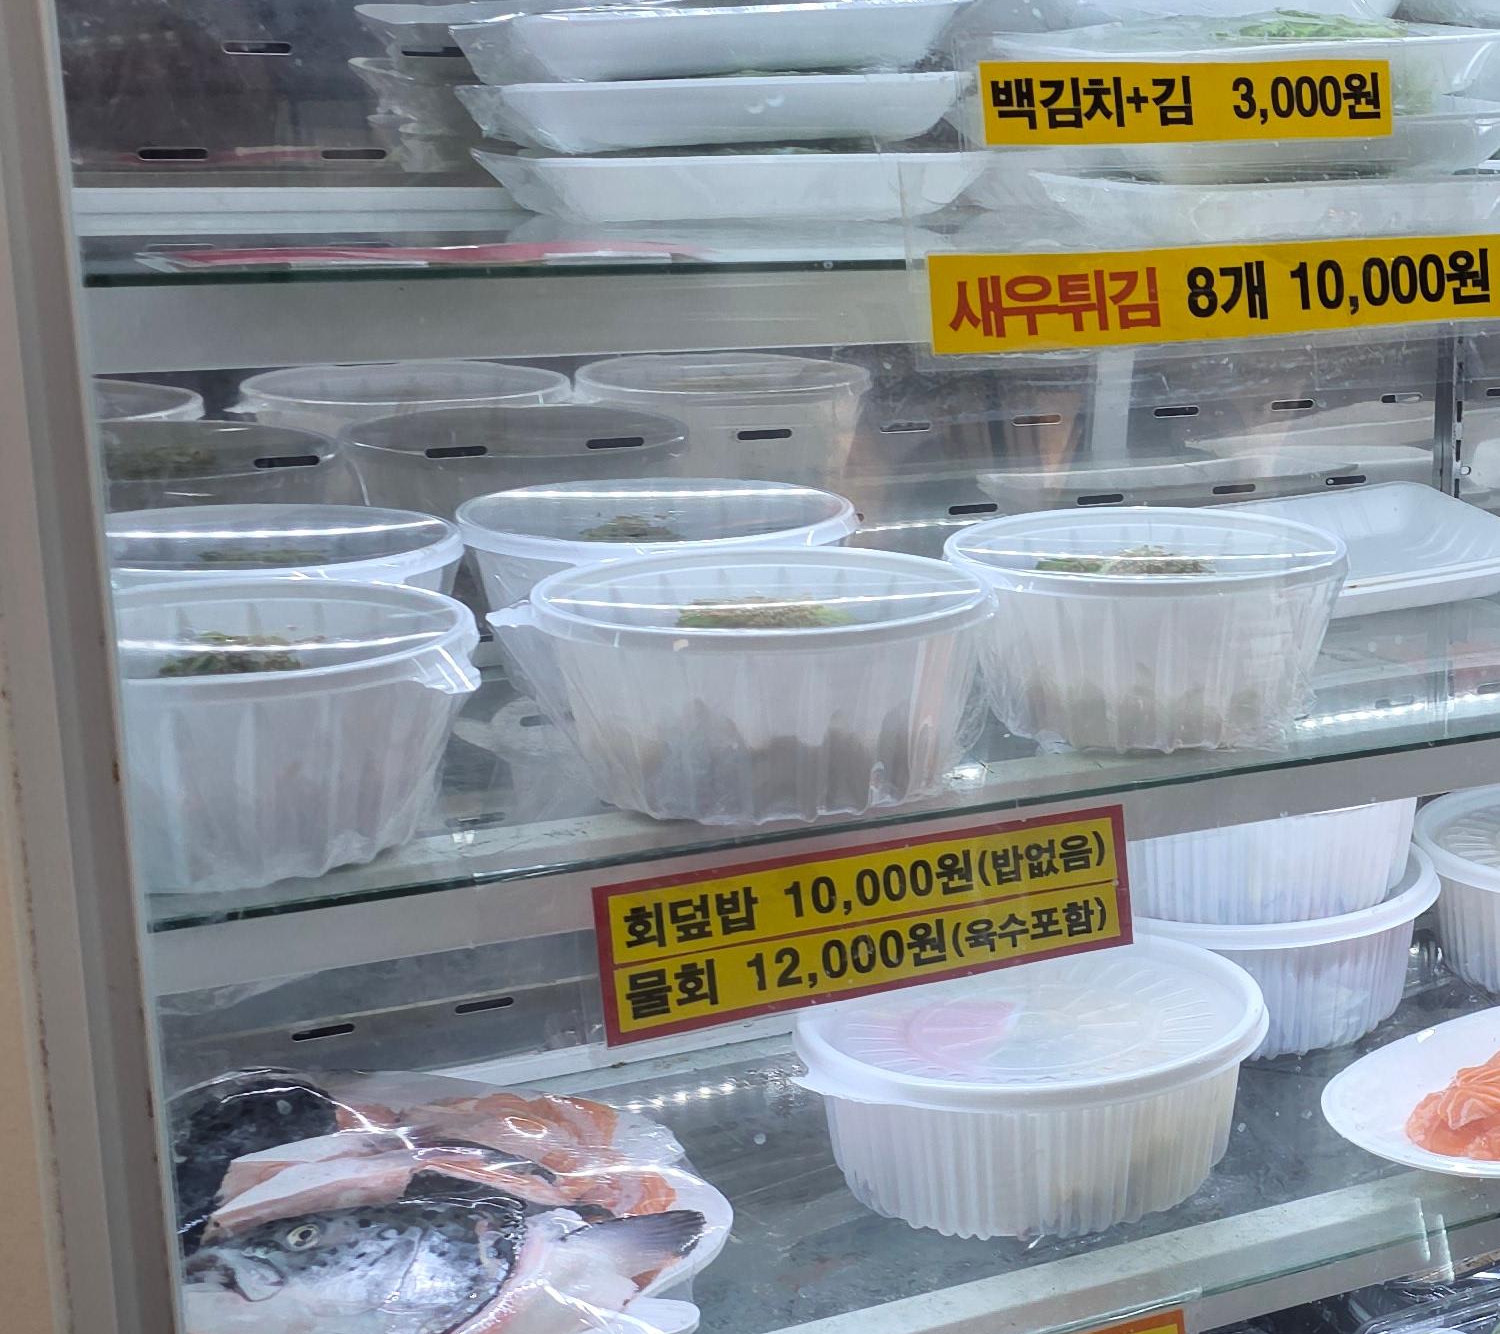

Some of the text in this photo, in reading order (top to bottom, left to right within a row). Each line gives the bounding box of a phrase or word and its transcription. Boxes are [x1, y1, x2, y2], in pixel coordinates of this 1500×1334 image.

[991, 71, 1382, 130] 백김치+김 3,000원
[948, 248, 1491, 338] 새우튀김 8개 10,000원
[623, 829, 1106, 950] 회덮밥 10,000원(밥없음)
[624, 894, 1108, 1021] 물회 12,000원(육수포함)
